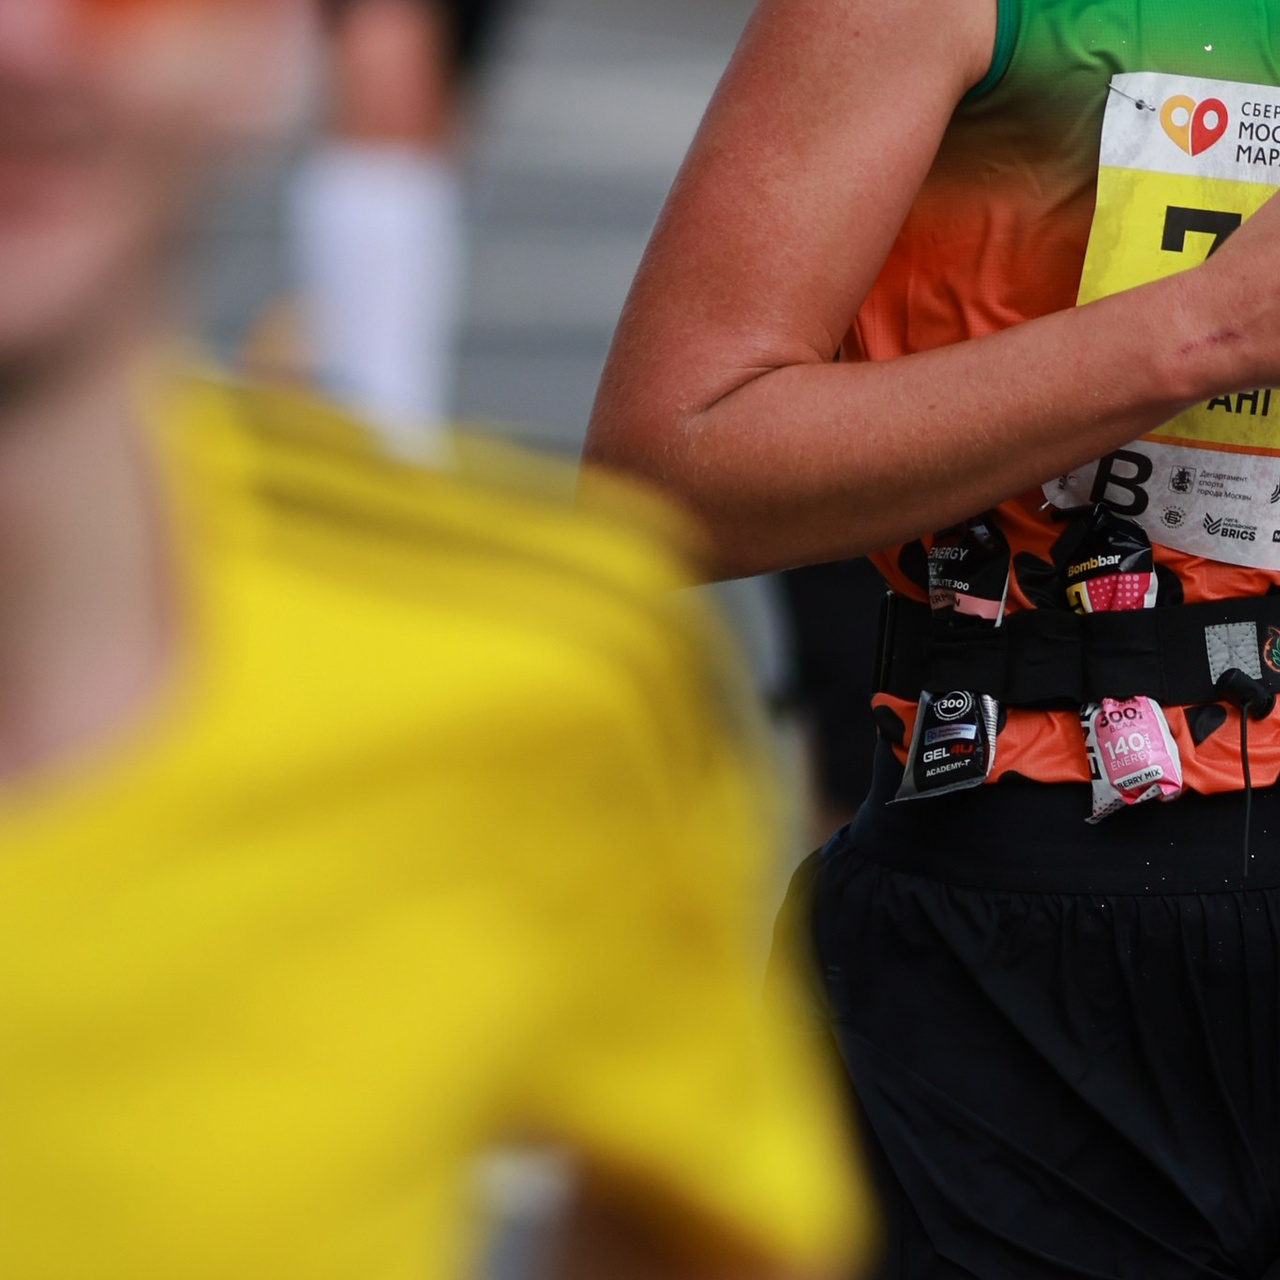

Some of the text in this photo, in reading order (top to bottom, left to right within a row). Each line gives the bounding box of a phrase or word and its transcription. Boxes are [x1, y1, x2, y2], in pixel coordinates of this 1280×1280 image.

[1200, 470, 1248, 482] Департамент
[1198, 480, 1224, 489] спорта
[1197, 488, 1252, 501] города Москвы
[1220, 527, 1256, 542] BRICS
[927, 547, 969, 561] ENERGY
[1068, 554, 1121, 577] Bombbar
[952, 580, 970, 591] 300
[940, 699, 964, 709] 300
[1109, 720, 1136, 733] BCAA
[1105, 732, 1145, 760] 140
[1110, 749, 1153, 771] ENERGY
[926, 759, 971, 777] ACADEMY-T
[1144, 768, 1160, 780] MIX
